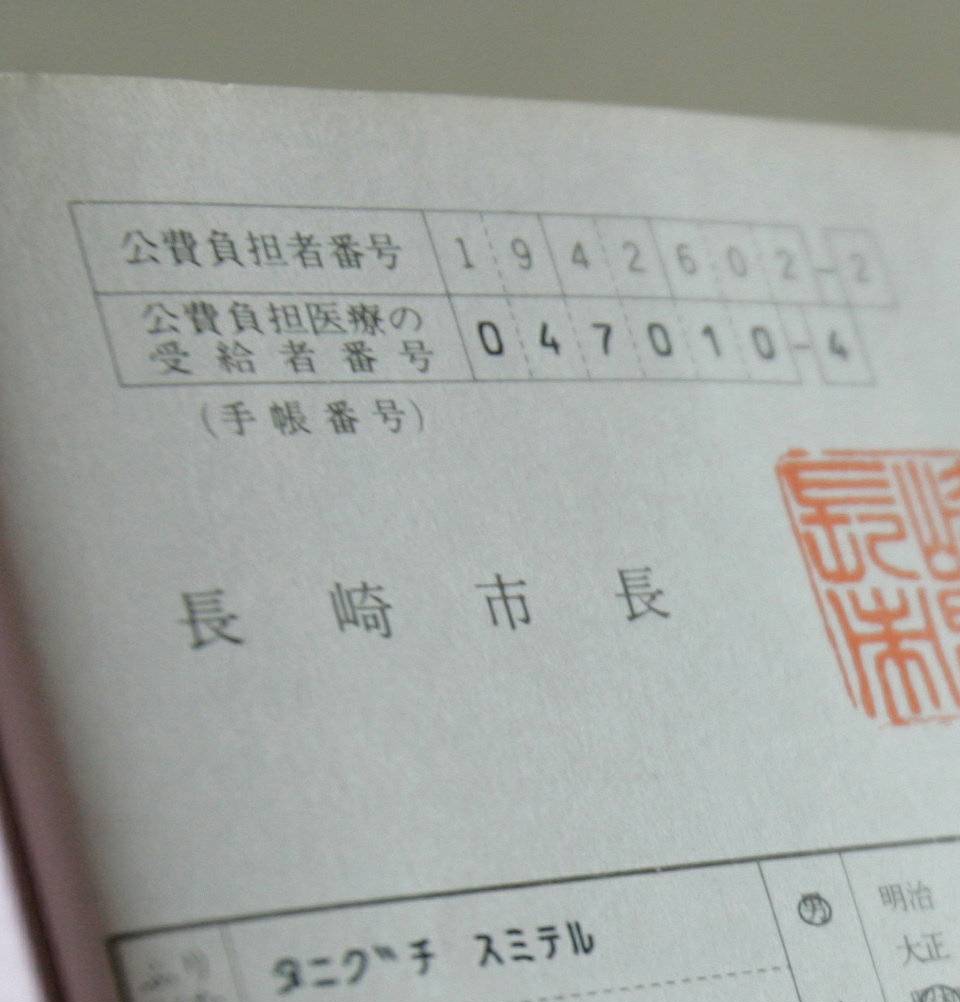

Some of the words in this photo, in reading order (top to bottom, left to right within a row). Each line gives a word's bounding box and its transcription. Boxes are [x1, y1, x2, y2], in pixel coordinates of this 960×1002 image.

[122, 228, 403, 272] 公費負担者番号
[143, 300, 423, 337] 公費負担医療の
[148, 340, 434, 376] 受給者番号
[878, 879, 933, 913] 明治
[473, 919, 598, 968] スミテル
[901, 931, 951, 967] 大正
